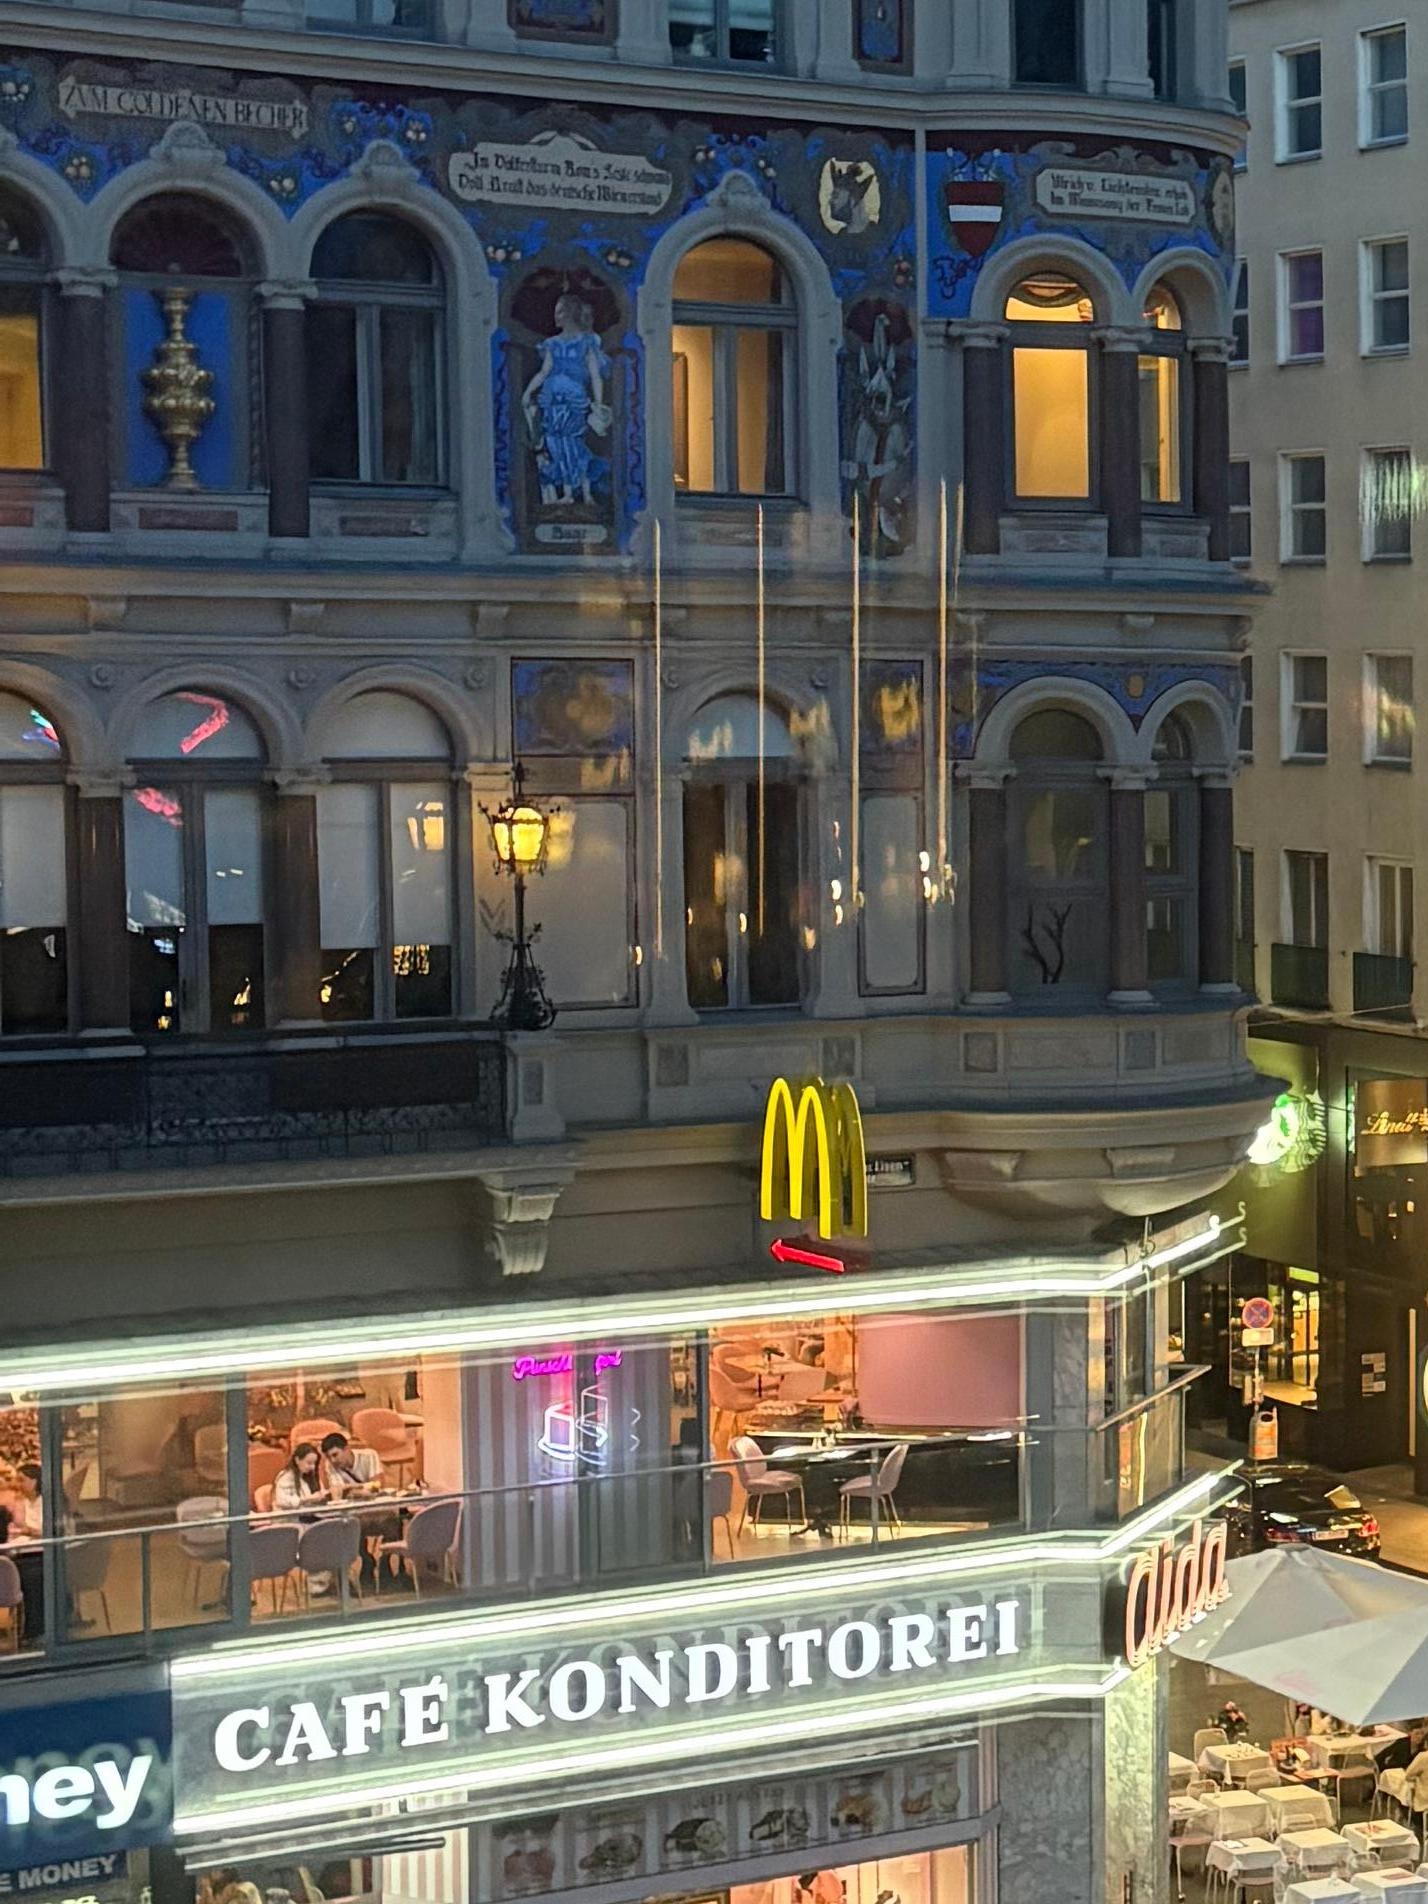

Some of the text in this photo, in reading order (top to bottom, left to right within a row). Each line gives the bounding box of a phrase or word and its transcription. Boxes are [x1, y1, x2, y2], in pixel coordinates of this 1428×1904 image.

[214, 1600, 1020, 1773] CAFÉ KONDITOREI
[18, 1854, 117, 1889] MONEY
